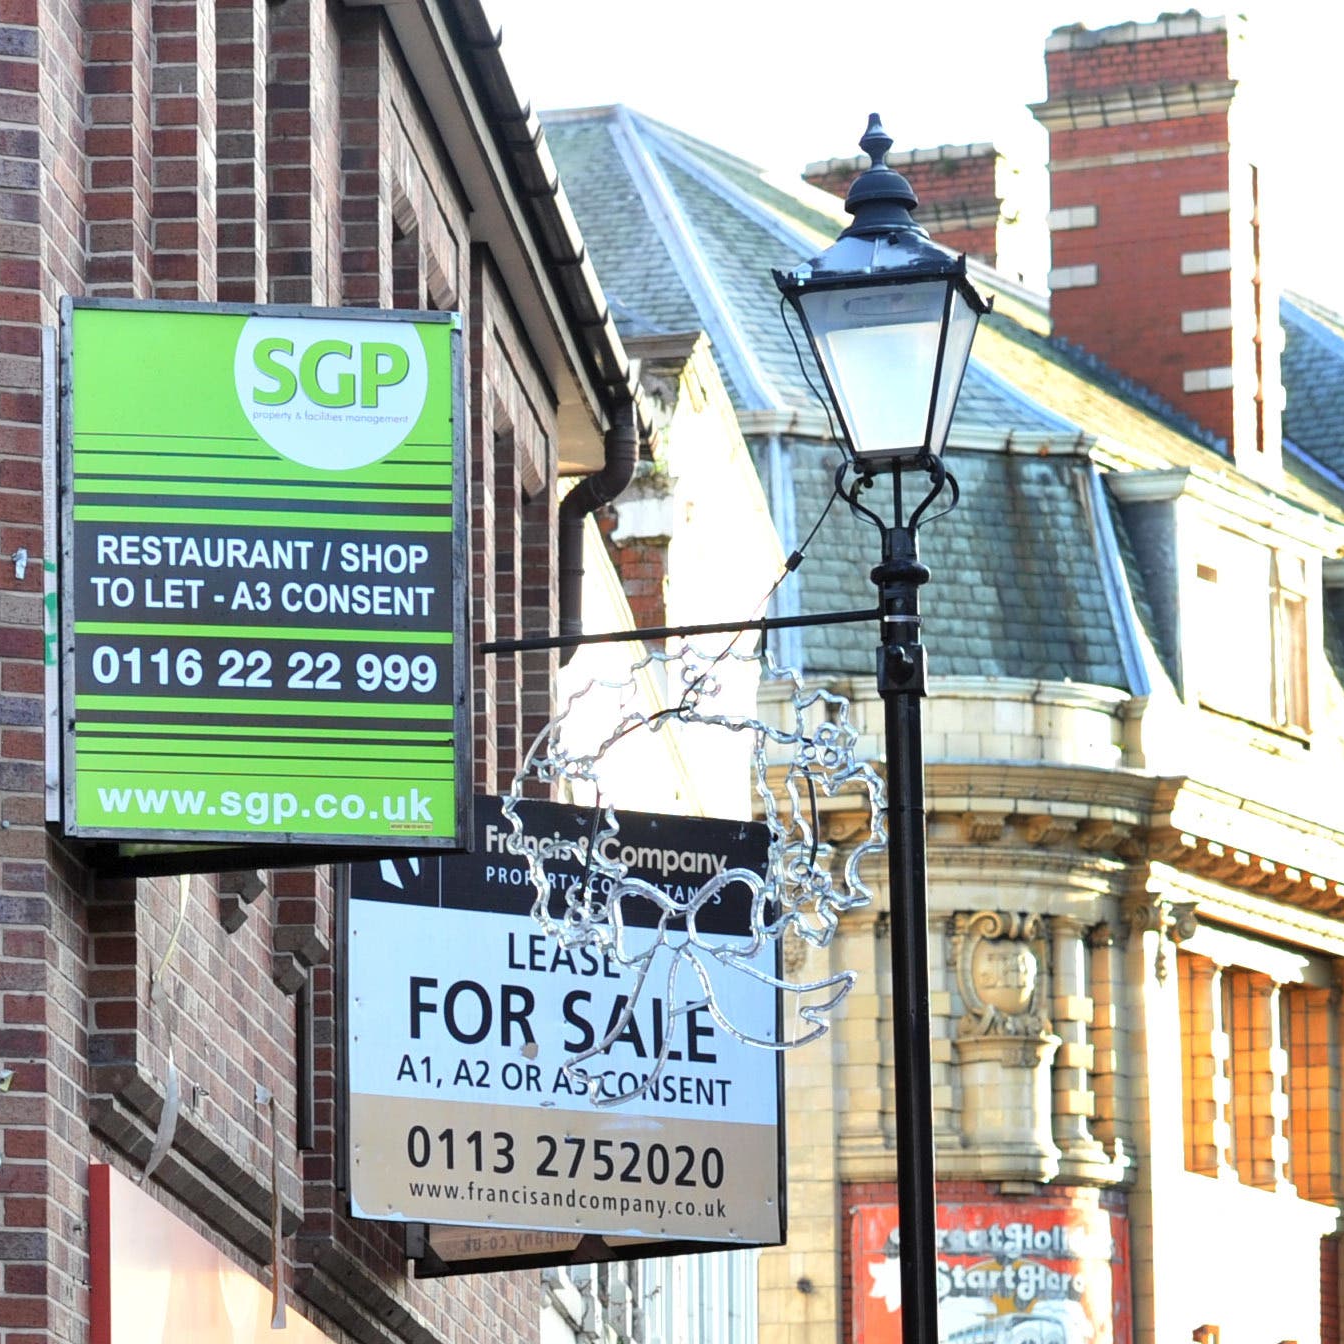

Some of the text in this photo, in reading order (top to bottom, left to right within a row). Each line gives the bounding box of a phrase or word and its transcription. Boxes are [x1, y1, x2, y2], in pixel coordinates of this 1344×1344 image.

[252, 336, 410, 410] SGP
[252, 411, 409, 424] property & facilities management
[97, 534, 429, 574] RESTAURANT / SHOP
[90, 576, 135, 608] TO
[145, 578, 204, 609] LET
[231, 581, 272, 612] A3
[282, 582, 435, 616] CONSENT
[91, 645, 438, 693] 0116 22 22 999
[97, 785, 434, 823] www.sgp.co.uk
[599, 836, 728, 877] Company
[486, 865, 581, 890] PROPRTY
[409, 976, 717, 1064] FOR SALE
[397, 1054, 732, 1107] A1, A2 OR A3 CONSENT
[406, 1125, 726, 1190] 0113 2752020
[409, 1181, 727, 1219] www.francisandcompany.co.uk
[937, 1259, 1016, 1298] Start
